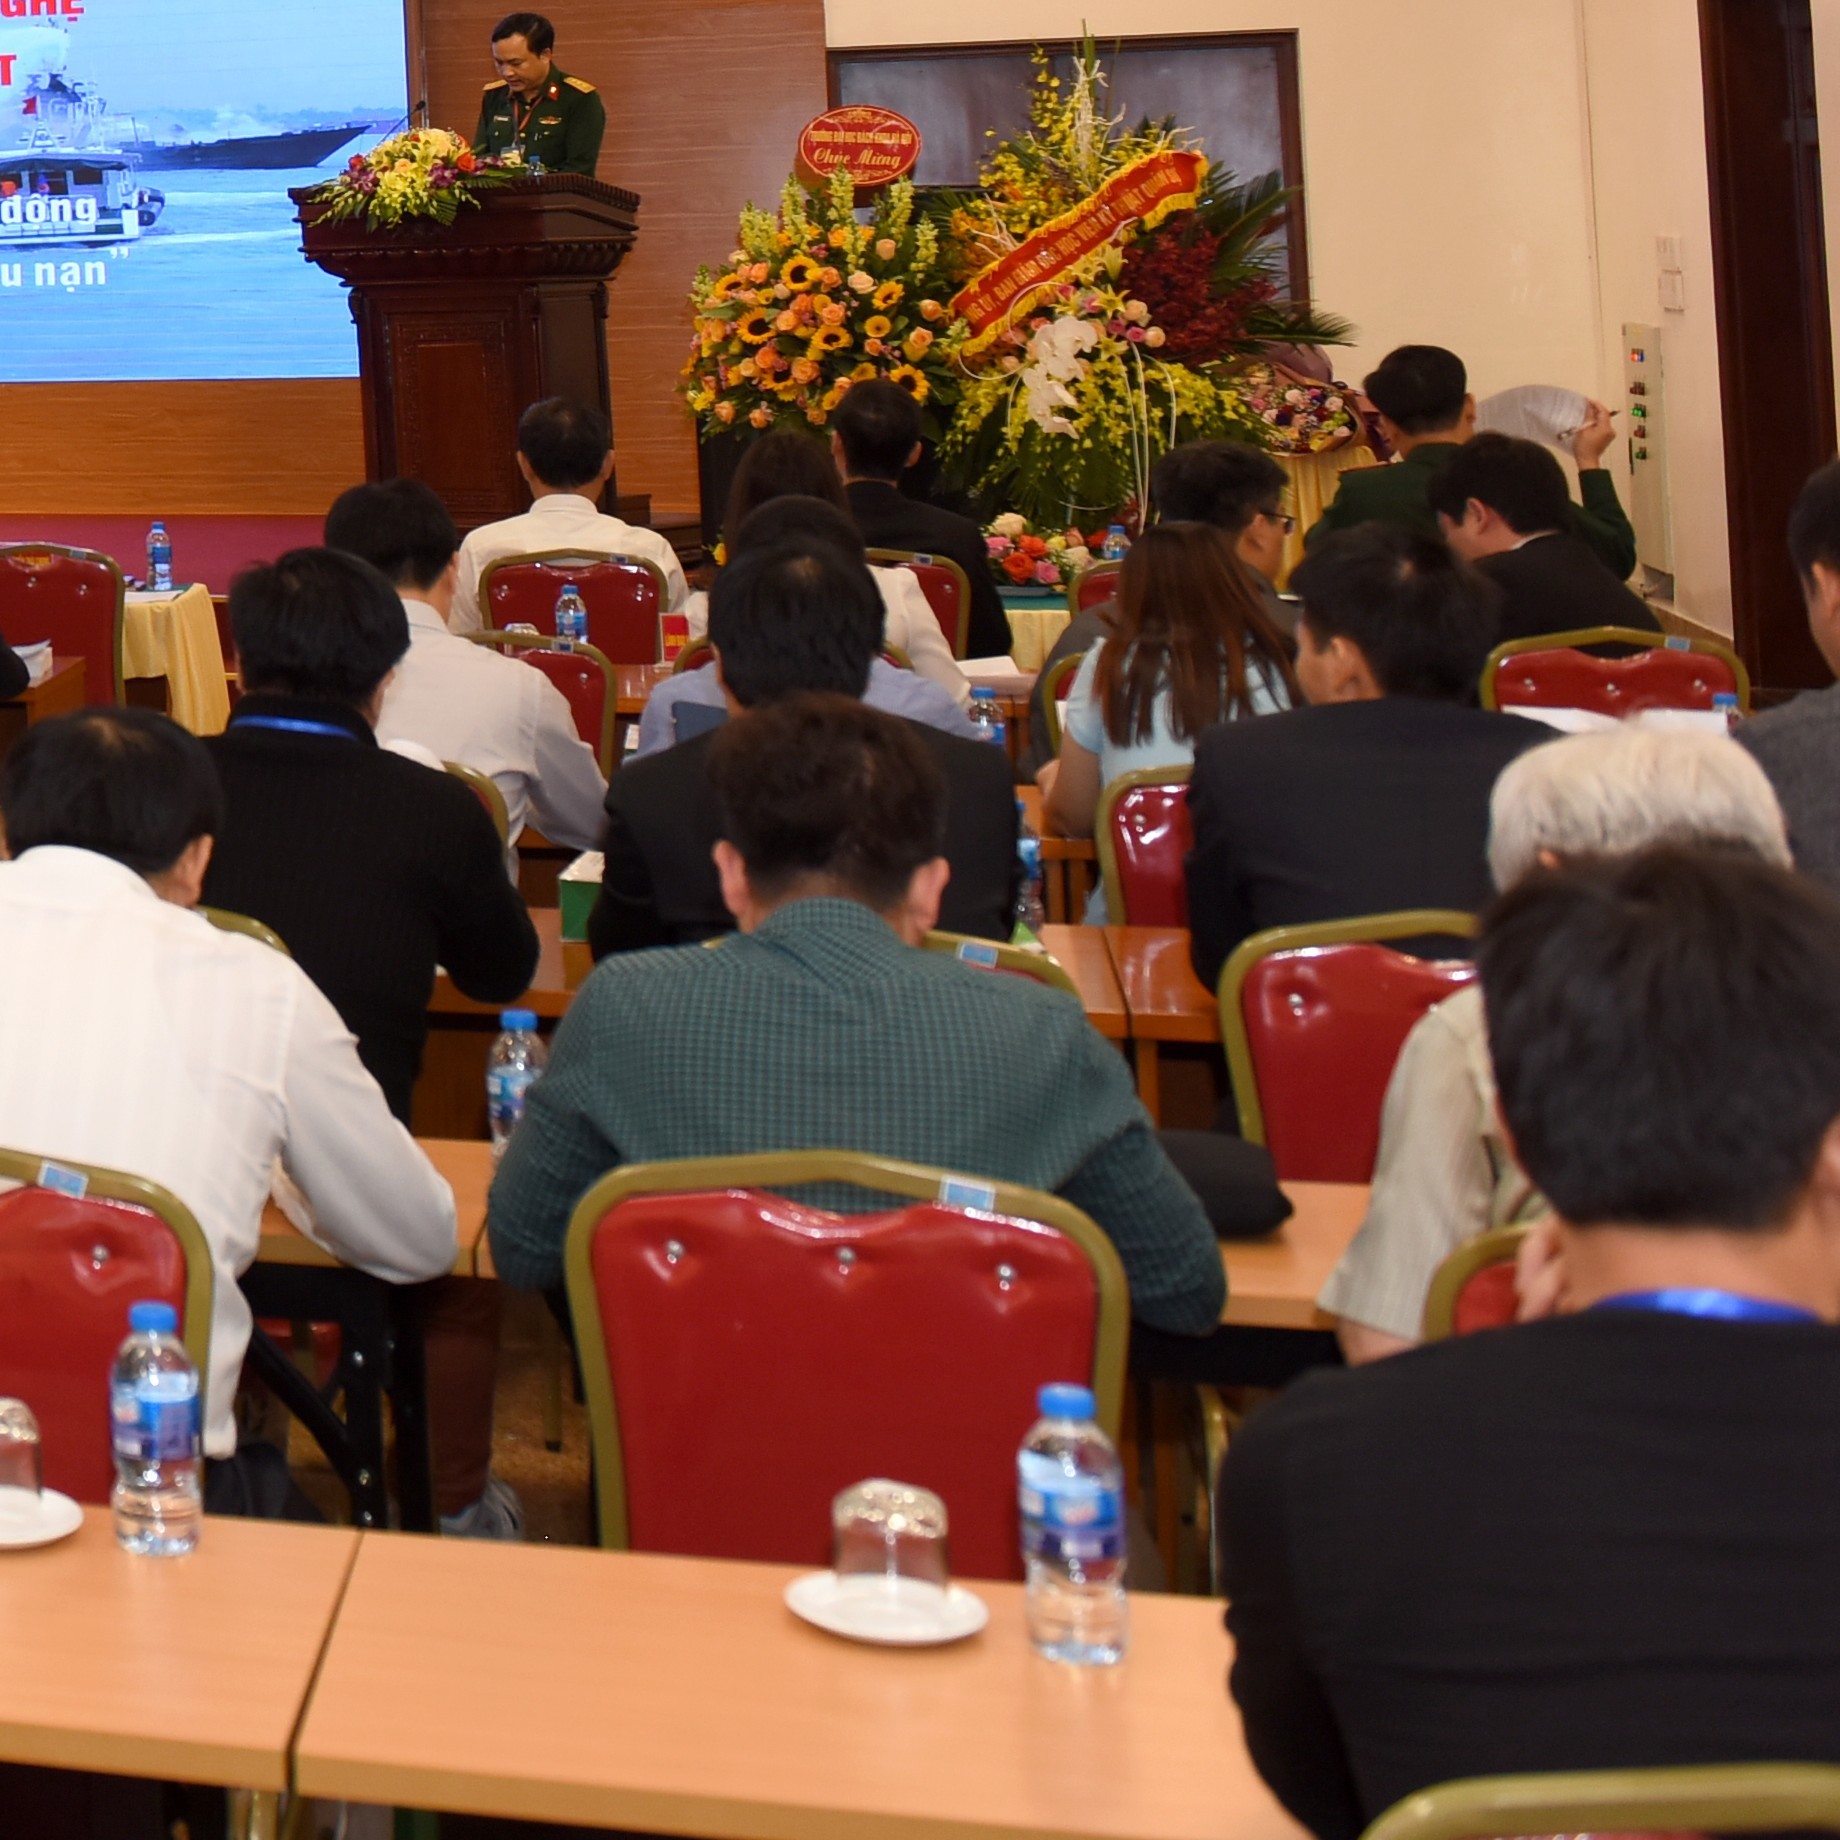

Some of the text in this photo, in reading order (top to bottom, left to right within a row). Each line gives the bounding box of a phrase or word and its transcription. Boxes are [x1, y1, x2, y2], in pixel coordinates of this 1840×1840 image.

[813, 146, 901, 169] Chúc Mừng
[0, 193, 98, 228] động
[994, 277, 1018, 300] BAN
